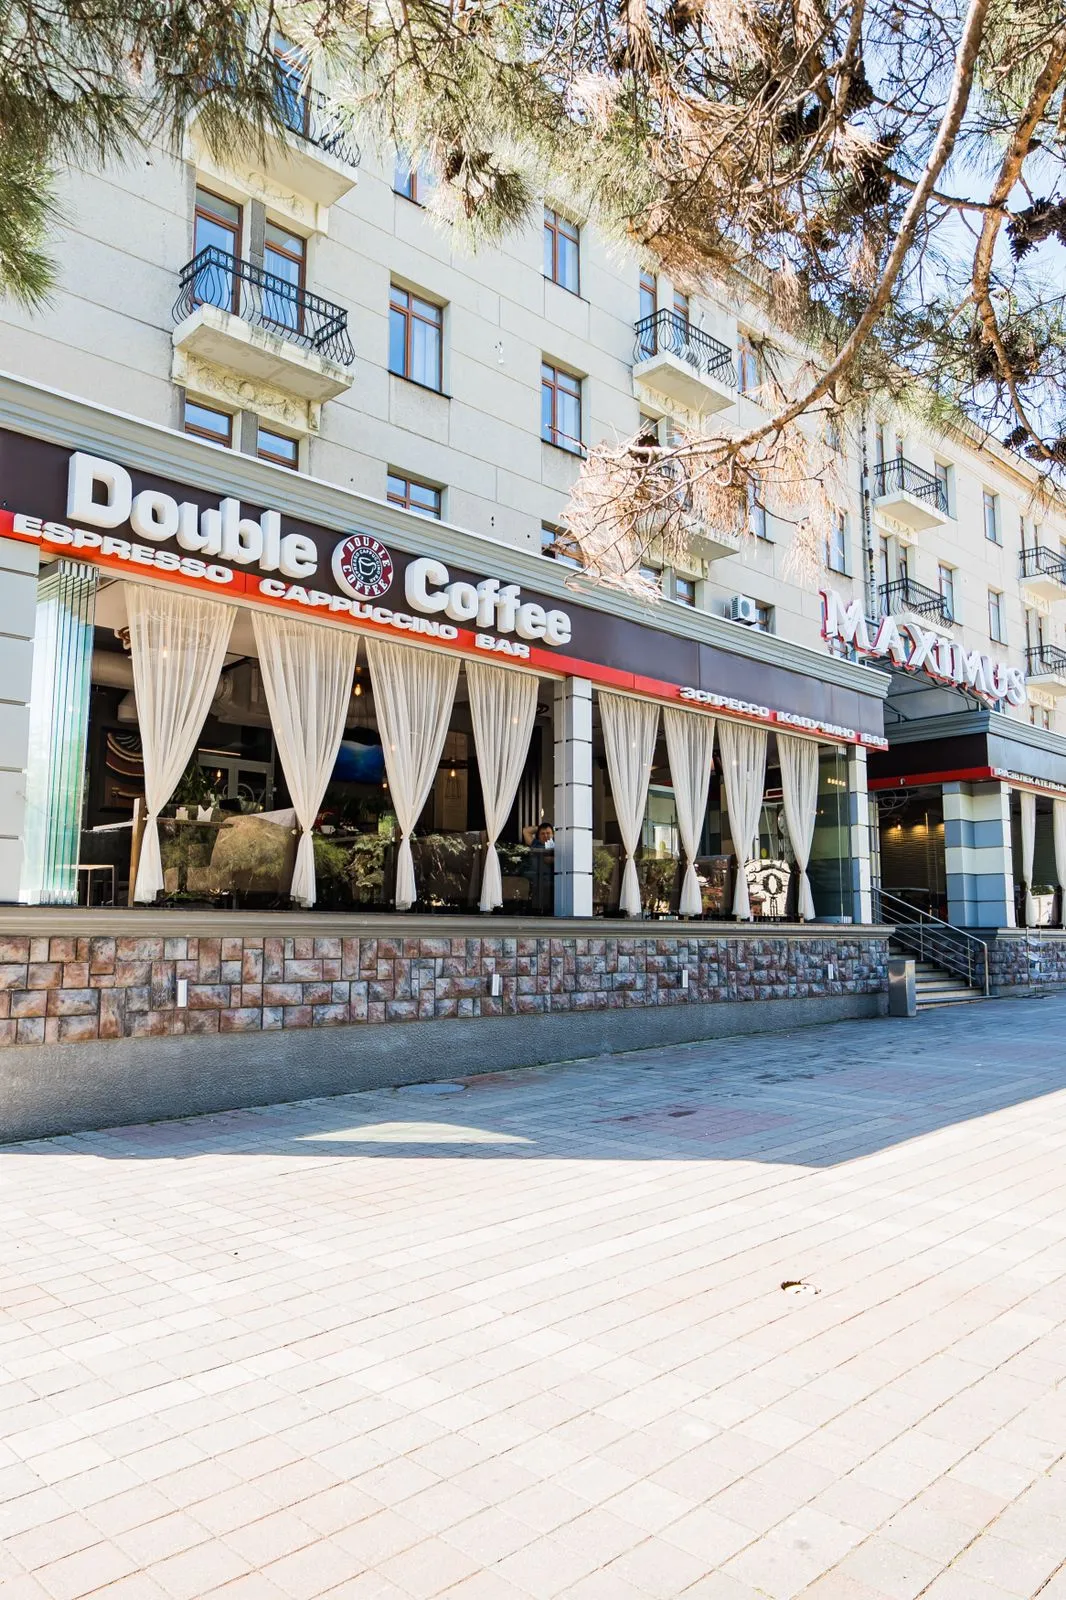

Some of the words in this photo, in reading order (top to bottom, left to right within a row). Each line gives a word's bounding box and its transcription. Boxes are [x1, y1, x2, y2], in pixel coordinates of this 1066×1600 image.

[13, 513, 234, 584] ESPRESSO
[258, 578, 458, 640] CAPPUCCINO
[475, 633, 531, 659] BAR
[67, 452, 318, 579] Double
[404, 557, 572, 646] Coffee
[342, 564, 388, 595] COFFEE
[346, 536, 390, 567] DOUBLE
[818, 588, 1027, 706] MAXIMUS
[679, 686, 770, 717] ЭСПРЕССО
[777, 710, 855, 739] КАПУЧИНО
[860, 733, 889, 746] БАР
